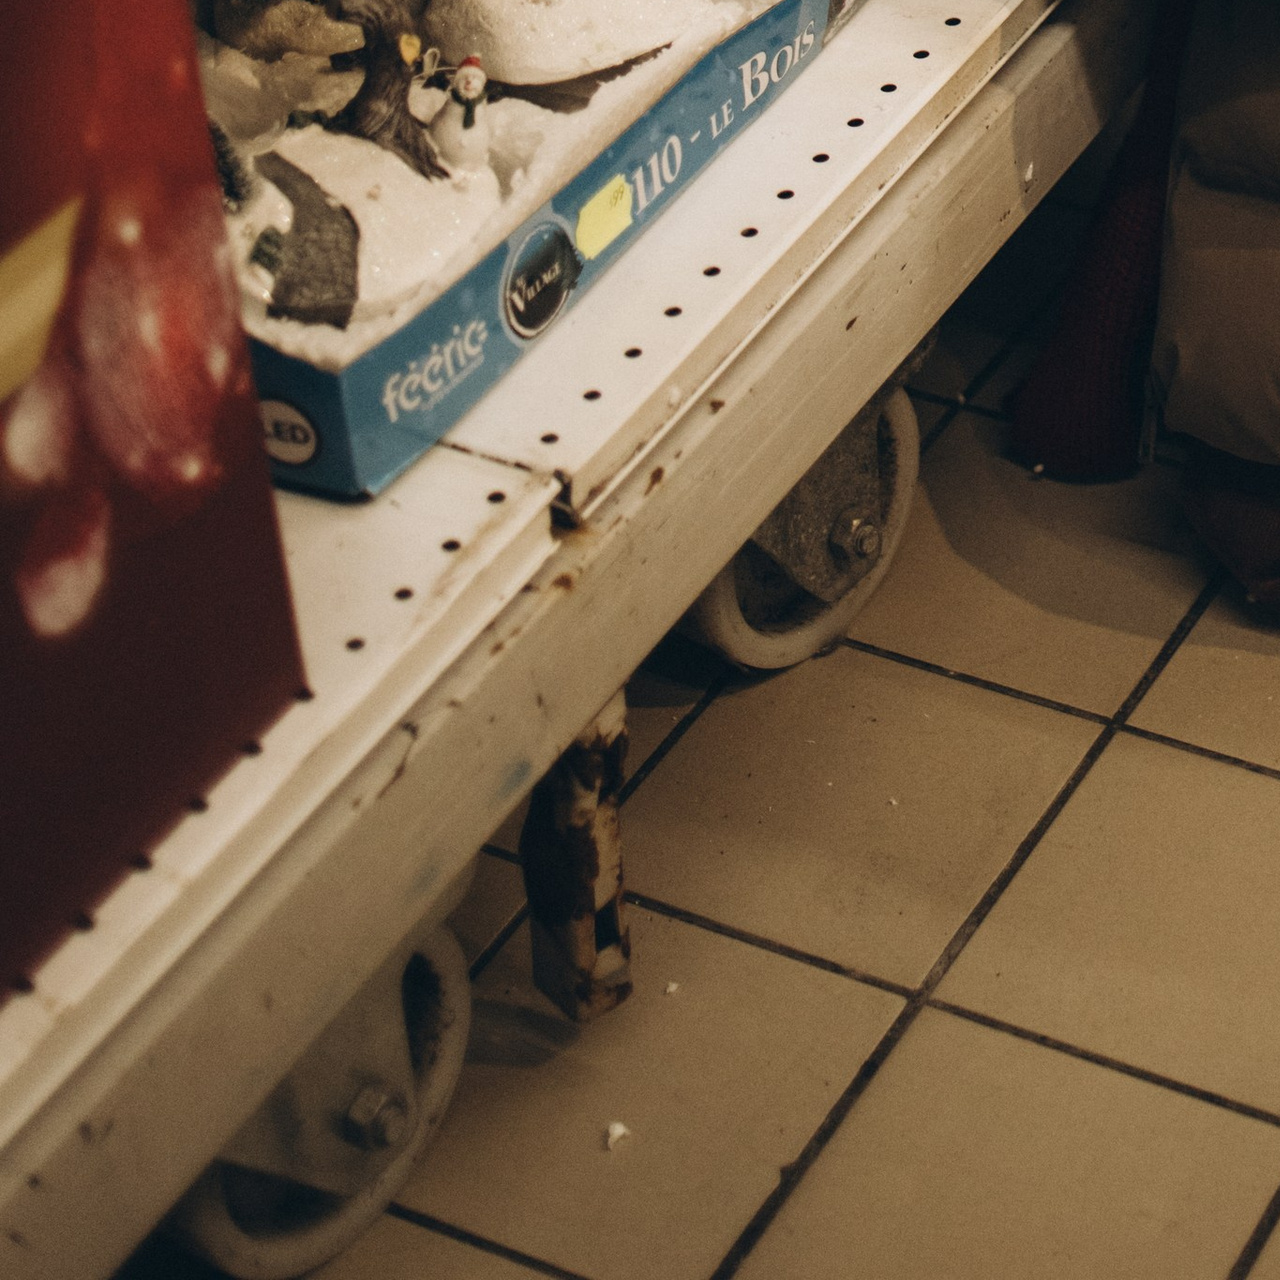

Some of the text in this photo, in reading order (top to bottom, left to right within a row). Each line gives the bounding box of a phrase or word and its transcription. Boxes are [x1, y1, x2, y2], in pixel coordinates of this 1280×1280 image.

[632, 134, 683, 216] 110
[709, 98, 735, 140] LE
[265, 418, 311, 446] ED
